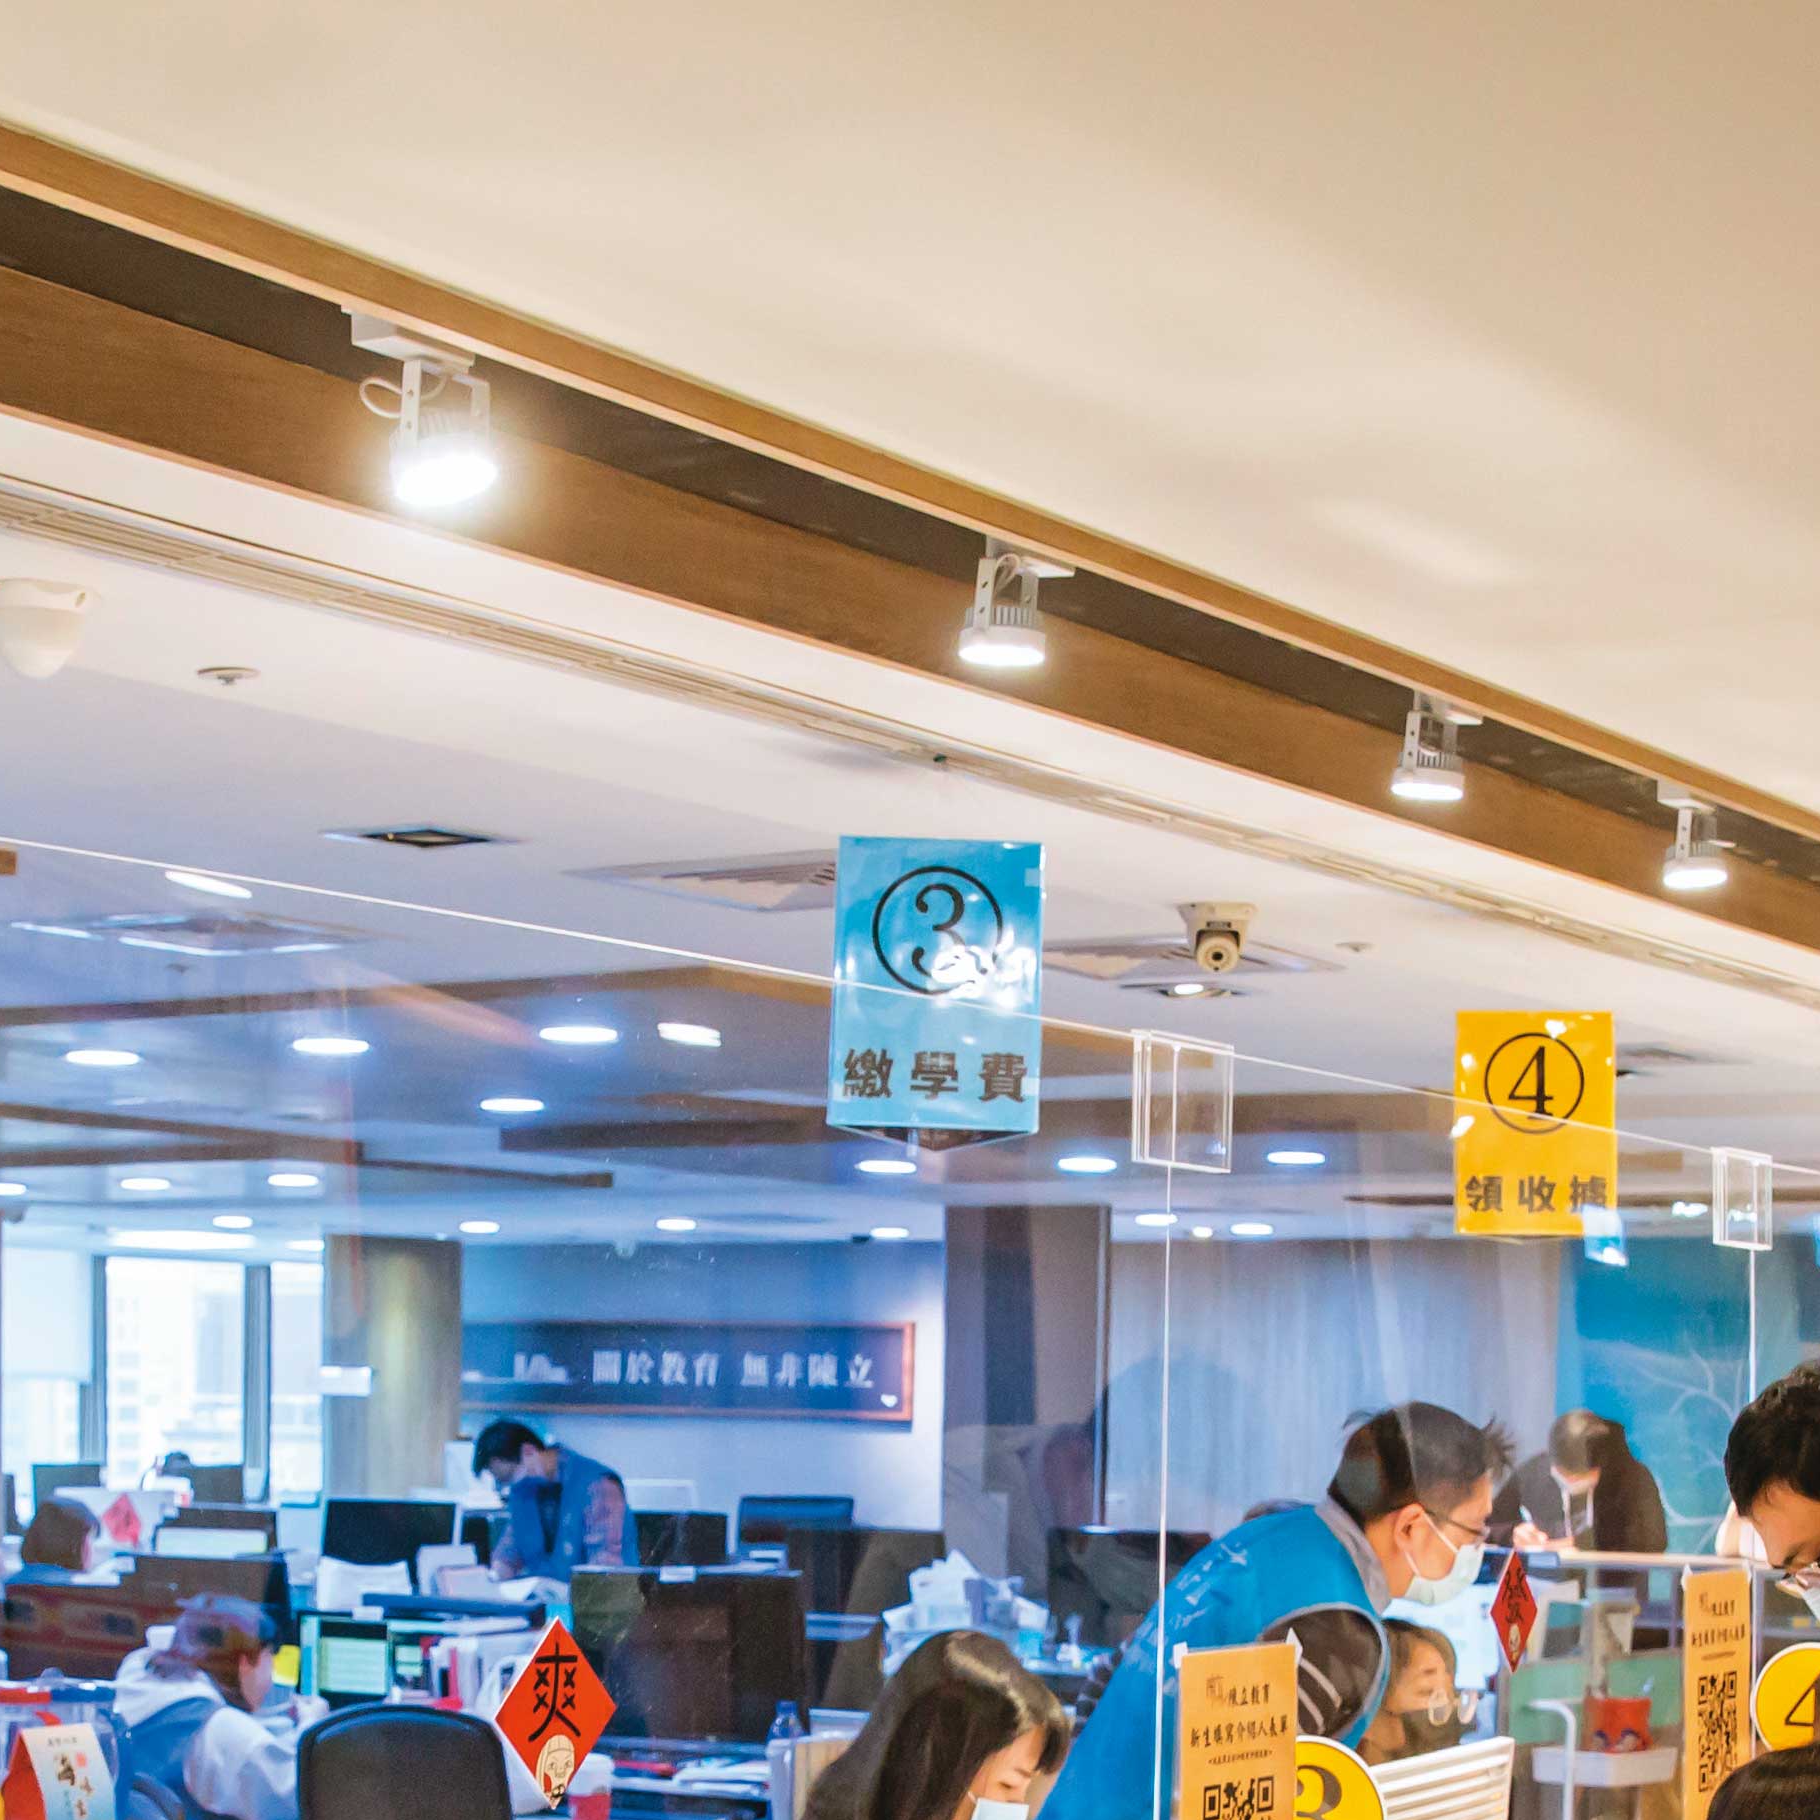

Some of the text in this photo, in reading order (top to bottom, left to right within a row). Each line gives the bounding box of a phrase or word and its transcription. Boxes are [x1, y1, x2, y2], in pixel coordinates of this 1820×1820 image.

[842, 1048, 1028, 1103] 繳學費
[528, 1641, 582, 1744] 爽
